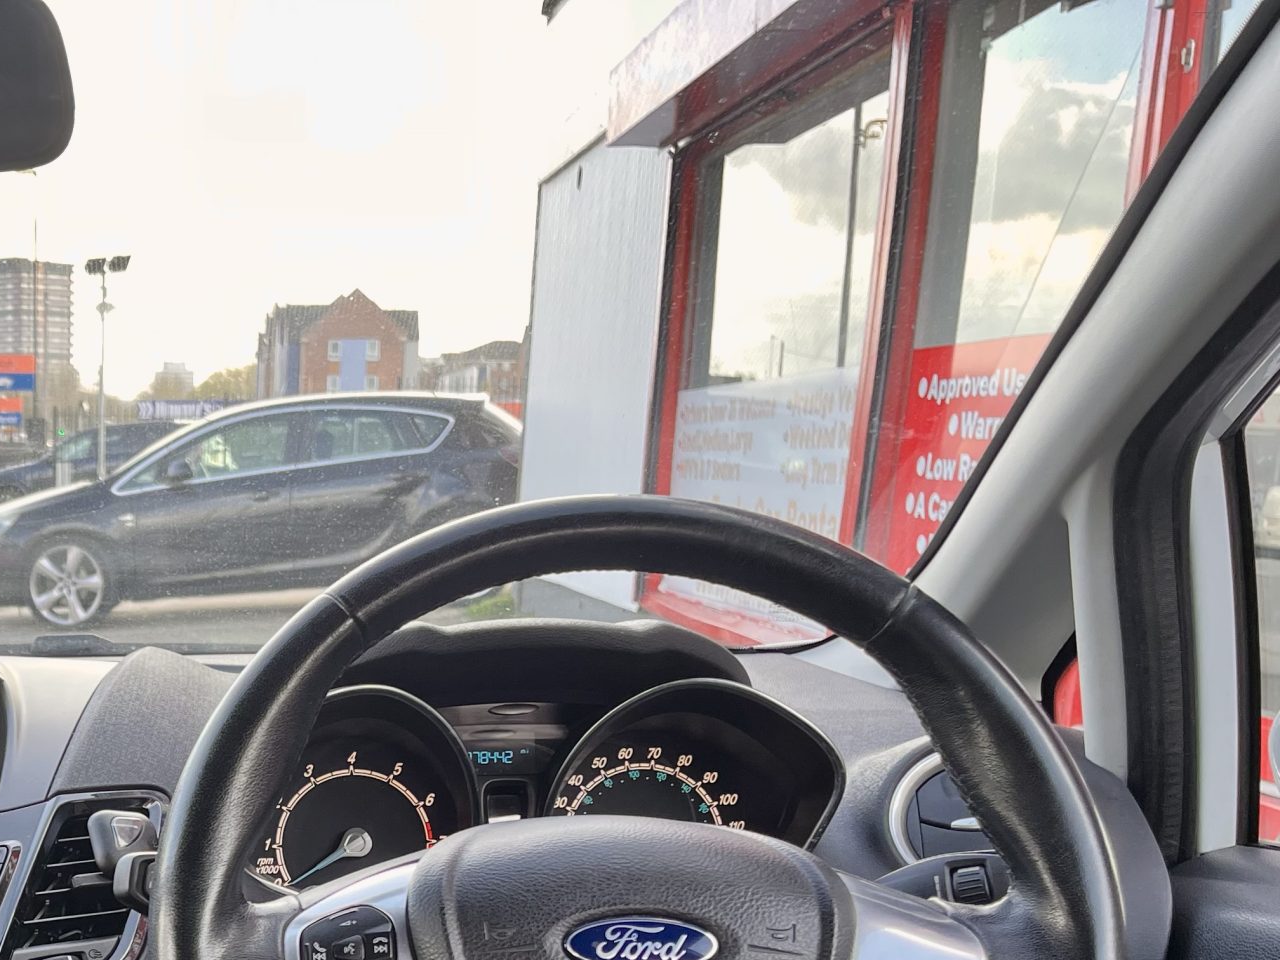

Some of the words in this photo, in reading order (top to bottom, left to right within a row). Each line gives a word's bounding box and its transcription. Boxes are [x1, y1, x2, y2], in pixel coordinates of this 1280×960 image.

[926, 369, 1001, 405] Approved
[925, 452, 957, 481] Low
[914, 491, 926, 520] A
[347, 751, 357, 764] 4
[617, 748, 634, 760] 60
[646, 747, 662, 759] 70
[591, 757, 608, 769] 50
[677, 755, 693, 766] 80
[304, 764, 314, 777] 3
[393, 763, 404, 775] 5
[568, 775, 584, 786] 40
[702, 772, 718, 783] 90
[425, 793, 436, 807] 6
[719, 794, 739, 805] 100
[264, 838, 271, 851] 1
[256, 857, 274, 868] rpm
